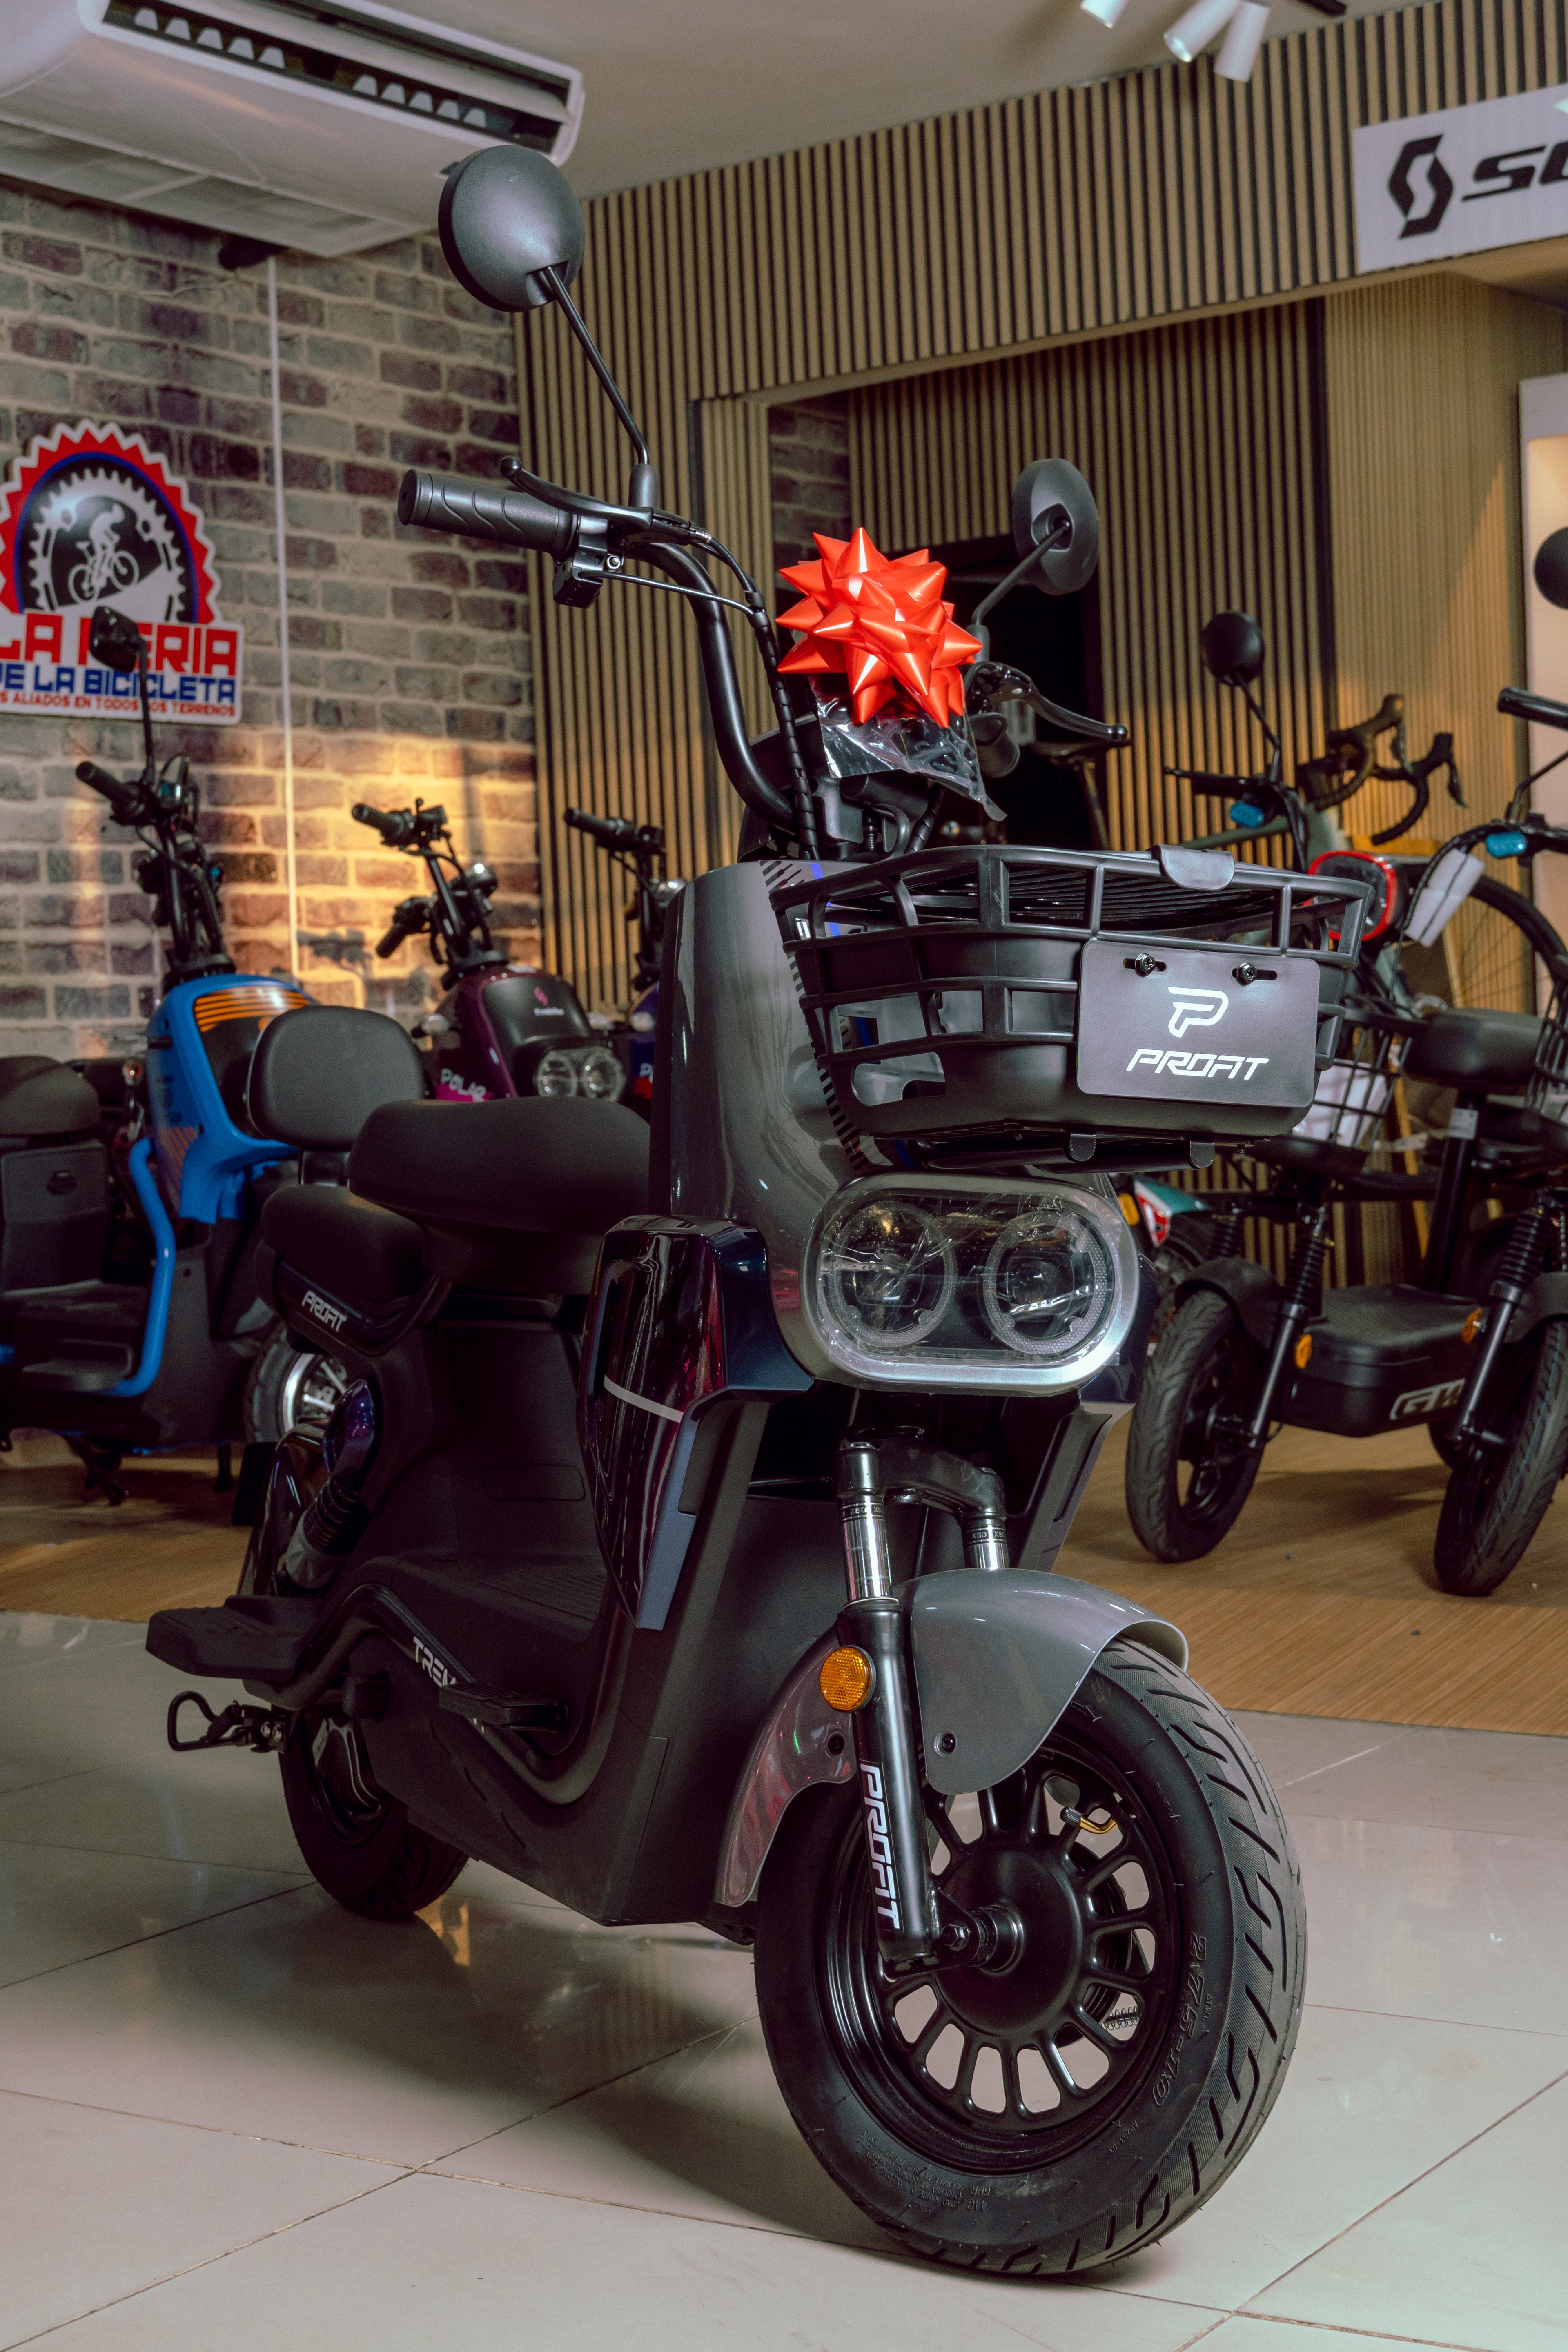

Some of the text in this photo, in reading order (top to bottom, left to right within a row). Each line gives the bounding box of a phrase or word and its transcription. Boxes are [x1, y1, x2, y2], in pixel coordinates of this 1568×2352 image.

[0, 664, 25, 690] E
[34, 665, 75, 693] LA
[13, 693, 70, 707] ALIADOS
[74, 695, 91, 708] EN
[96, 696, 138, 712] TODOS
[1125, 1048, 1270, 1080] PROFIT
[301, 1290, 347, 1332] PROFIT
[860, 1763, 900, 1929] PROFIT
